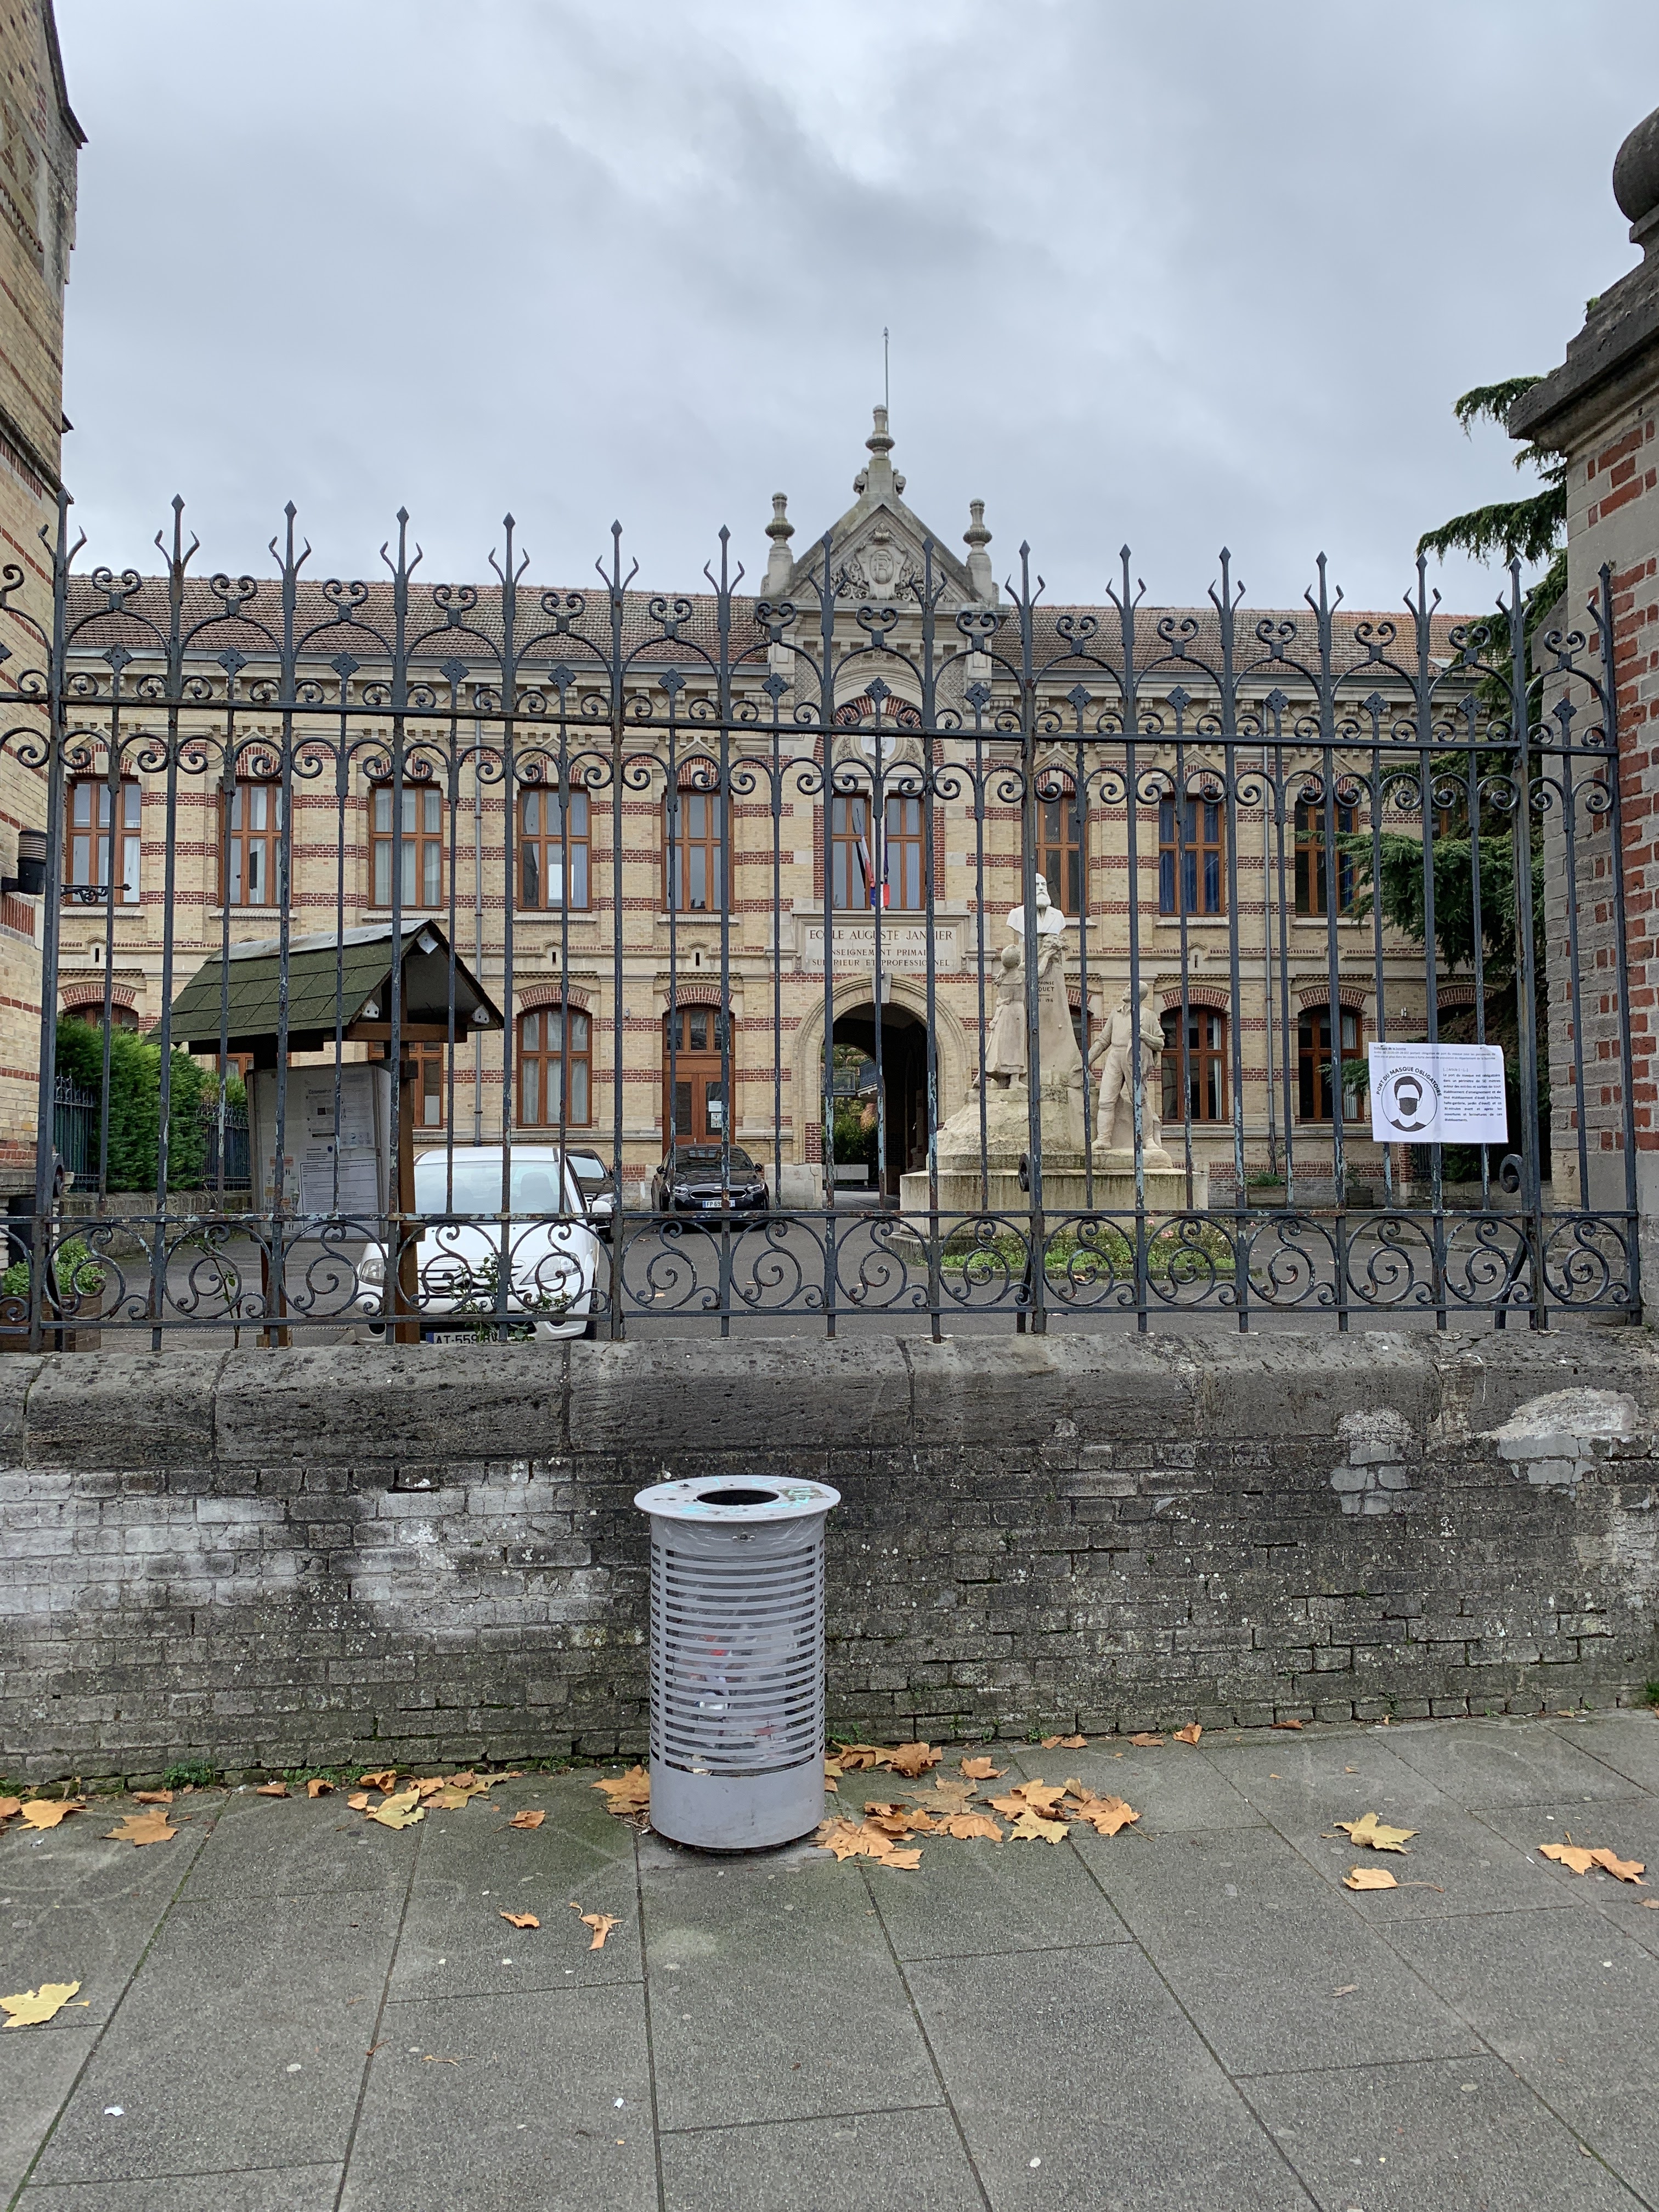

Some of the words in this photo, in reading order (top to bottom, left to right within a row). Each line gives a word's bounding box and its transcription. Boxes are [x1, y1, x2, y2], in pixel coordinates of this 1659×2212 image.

[810, 930, 844, 940] ECLE
[906, 930, 953, 940] JANIER
[1376, 1080, 1384, 1095] PORT
[1390, 1067, 1414, 1075] MASQUE
[1415, 1068, 1442, 1097] OBLIGATOIRE
